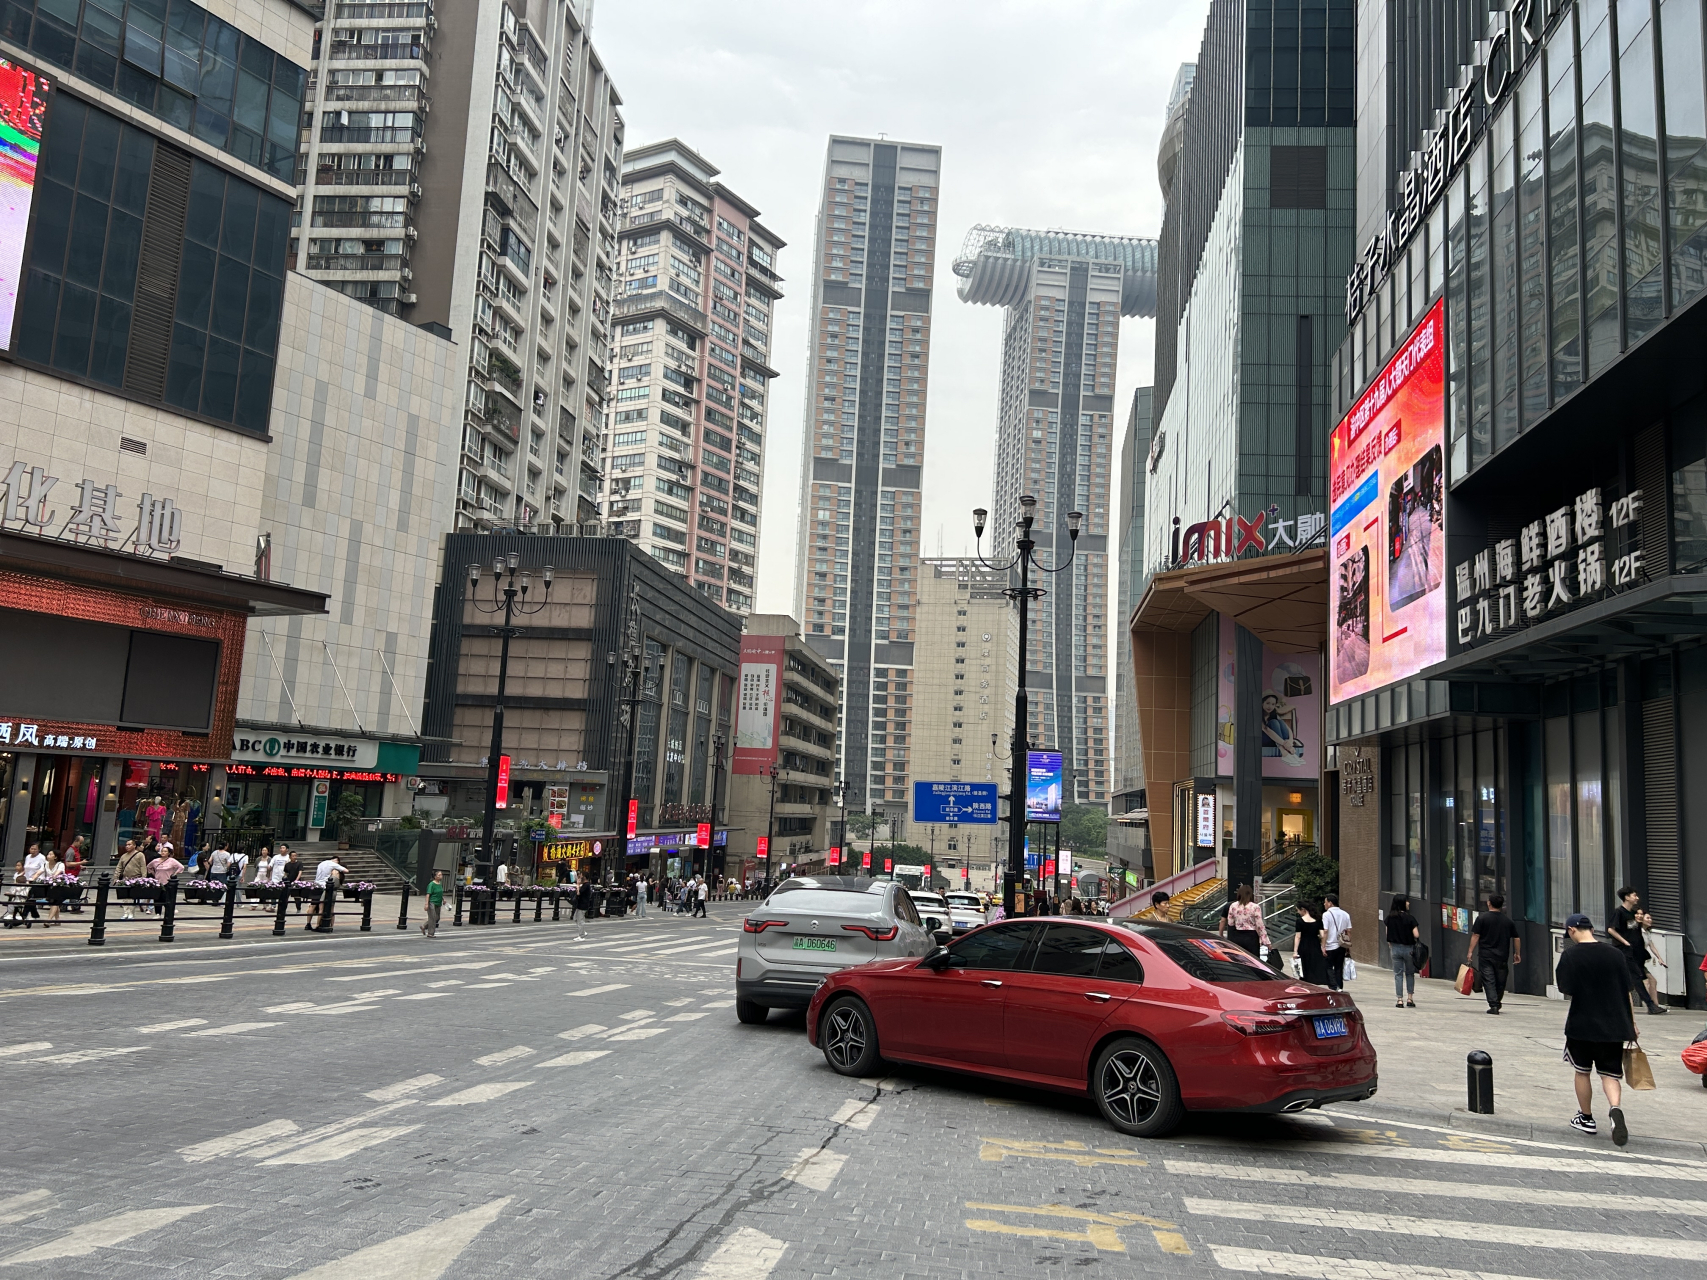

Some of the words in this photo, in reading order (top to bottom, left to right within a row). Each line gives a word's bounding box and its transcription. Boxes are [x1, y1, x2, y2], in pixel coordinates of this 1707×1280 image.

[1345, 78, 1475, 326] 桔子水晶酒店
[0, 461, 182, 553] 化基地
[1456, 487, 1604, 603] 温州海鲜酒楼
[1609, 490, 1643, 529] 12F
[1457, 542, 1606, 644] 巴九门老火锅
[1611, 550, 1645, 586] 12F
[283, 740, 357, 757] 中国农业银行
[932, 784, 971, 792] 嘉陵江滨江路
